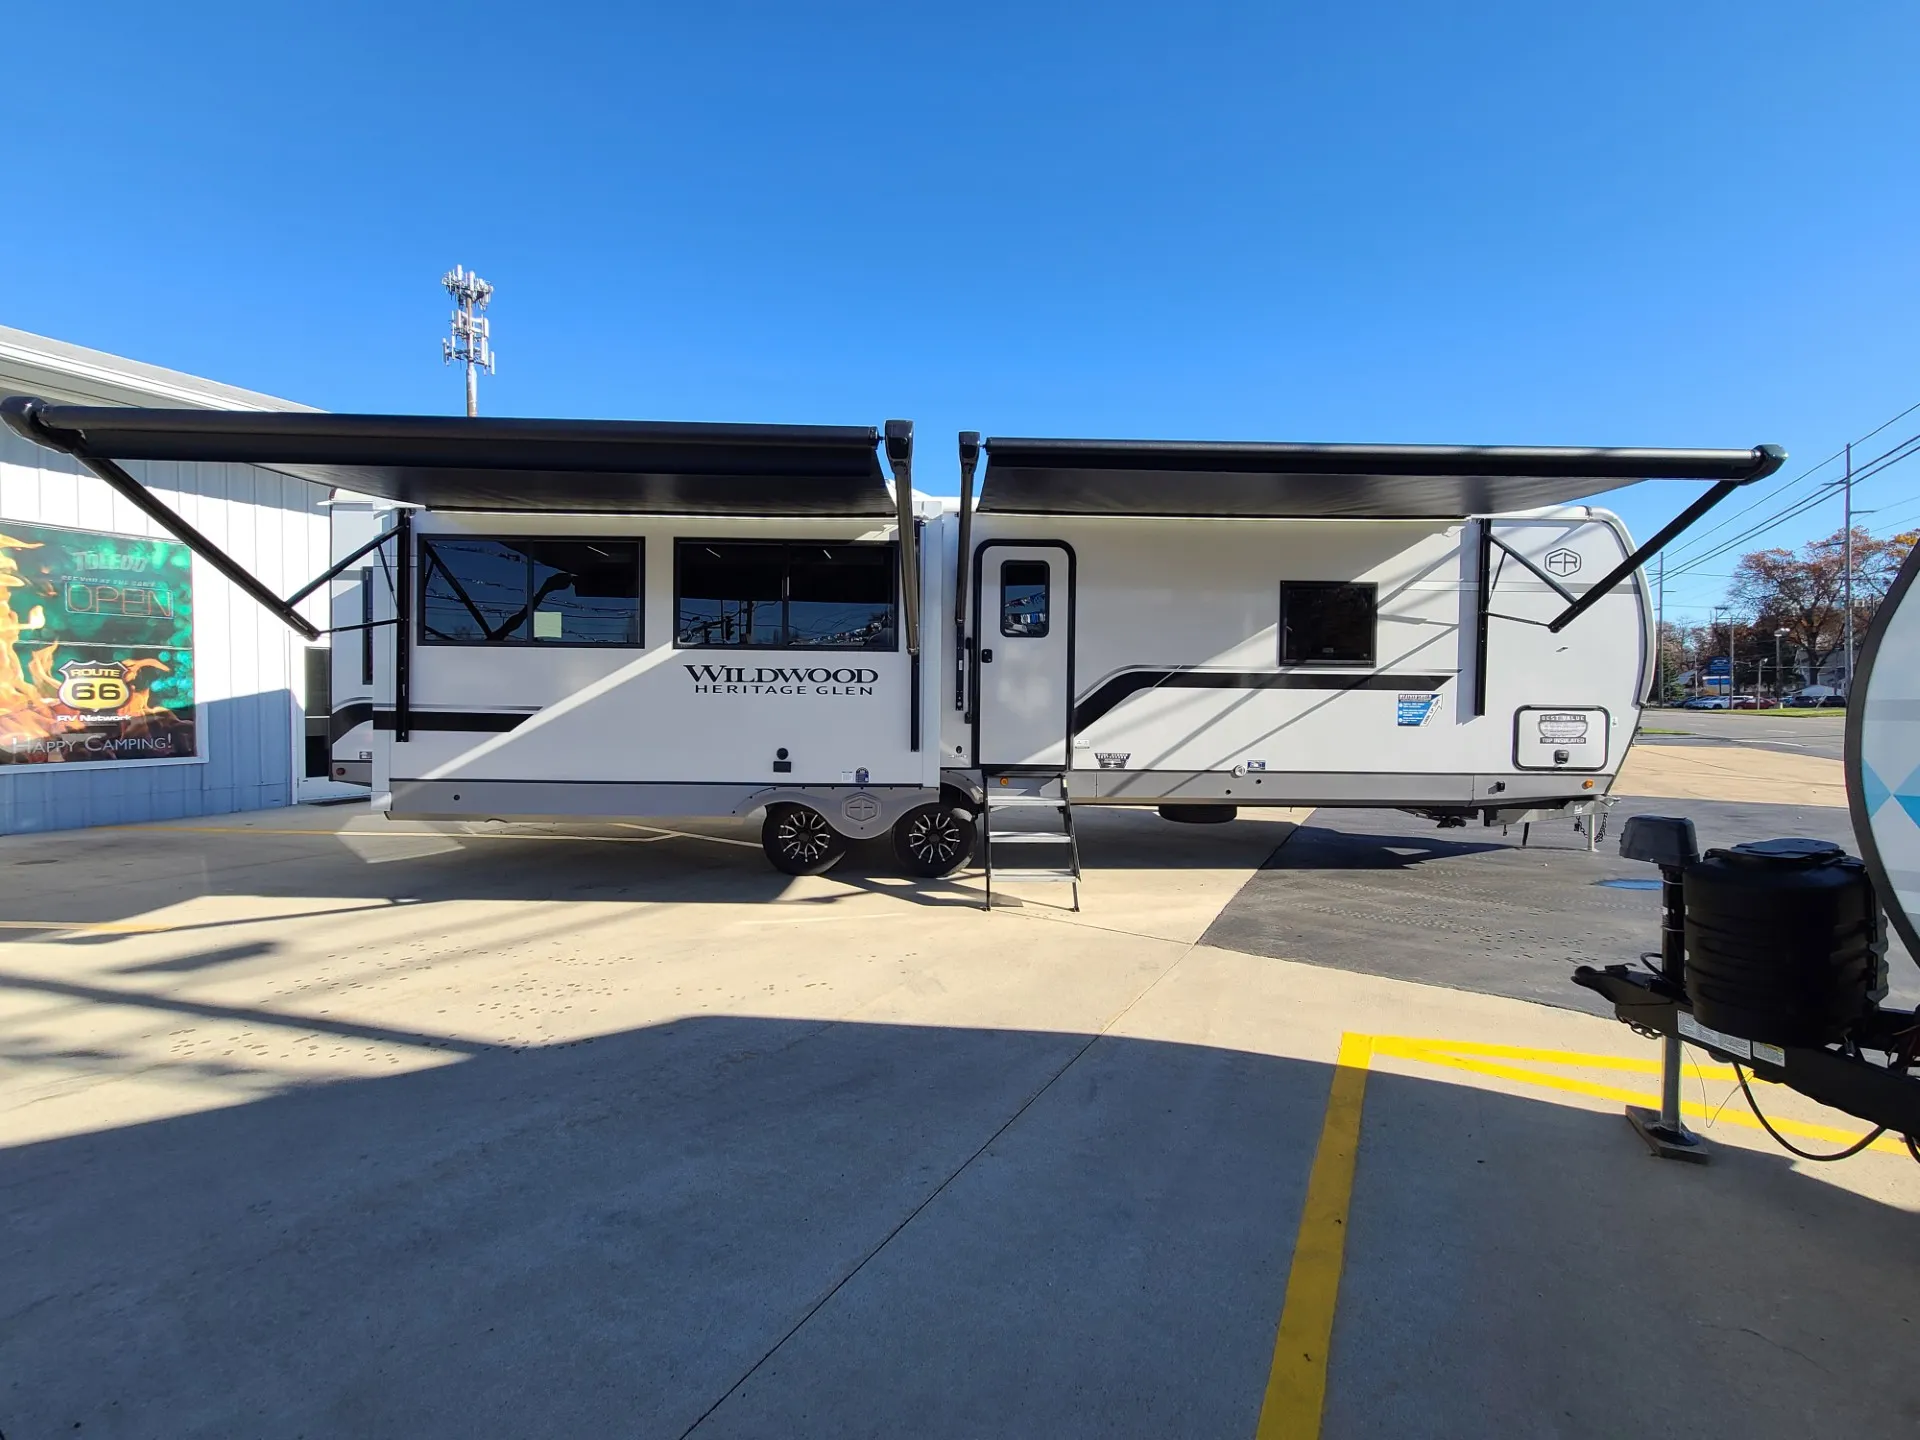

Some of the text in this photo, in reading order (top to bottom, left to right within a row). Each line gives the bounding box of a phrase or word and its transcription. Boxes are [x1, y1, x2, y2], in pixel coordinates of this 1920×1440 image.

[68, 584, 171, 617] OPEN
[70, 668, 121, 677] ROUTE
[683, 664, 879, 684] WILDWOOD
[71, 682, 121, 700] 66
[695, 684, 873, 696] HERITAGE GLEN
[79, 714, 131, 722] Network
